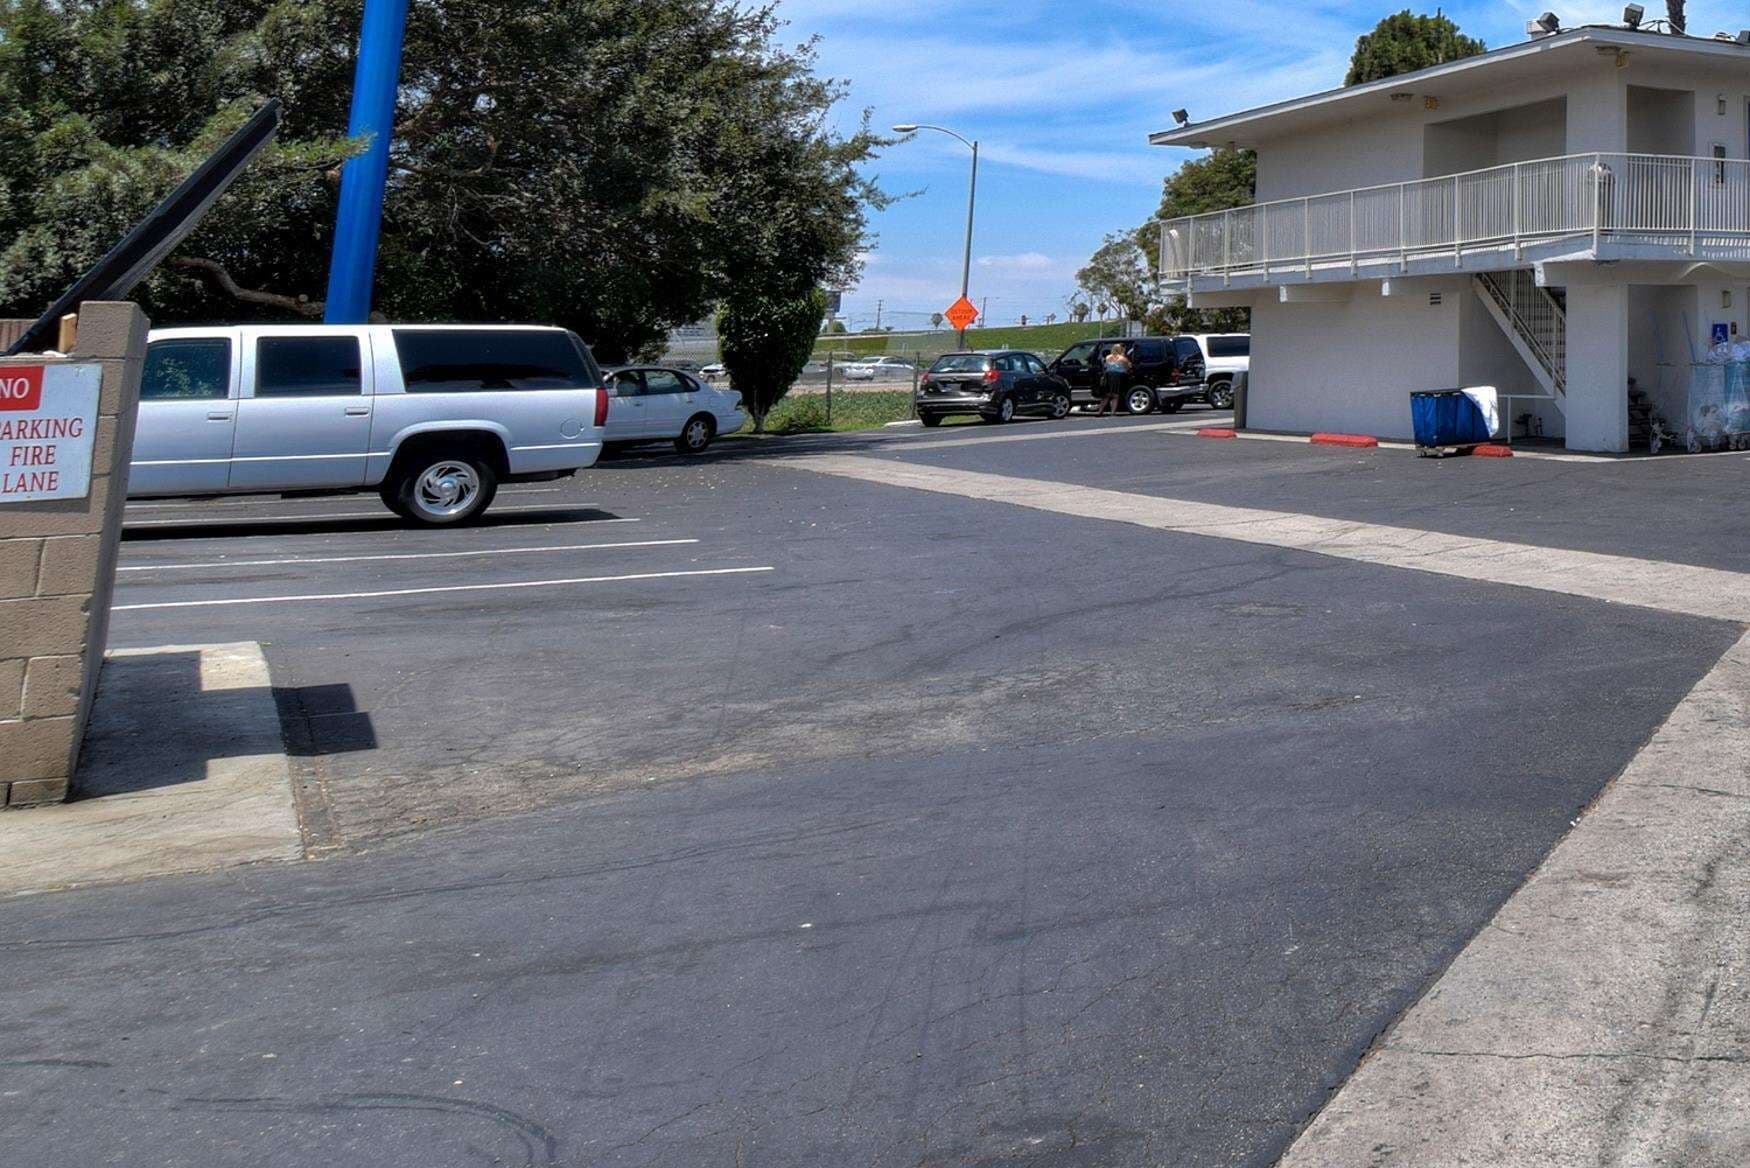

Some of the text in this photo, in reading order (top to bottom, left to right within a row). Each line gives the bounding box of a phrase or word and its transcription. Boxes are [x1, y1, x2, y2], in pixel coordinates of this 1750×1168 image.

[0, 378, 30, 399] NO
[0, 417, 84, 440] ARKING
[10, 445, 57, 466] FIRE
[3, 471, 59, 493] LANE
